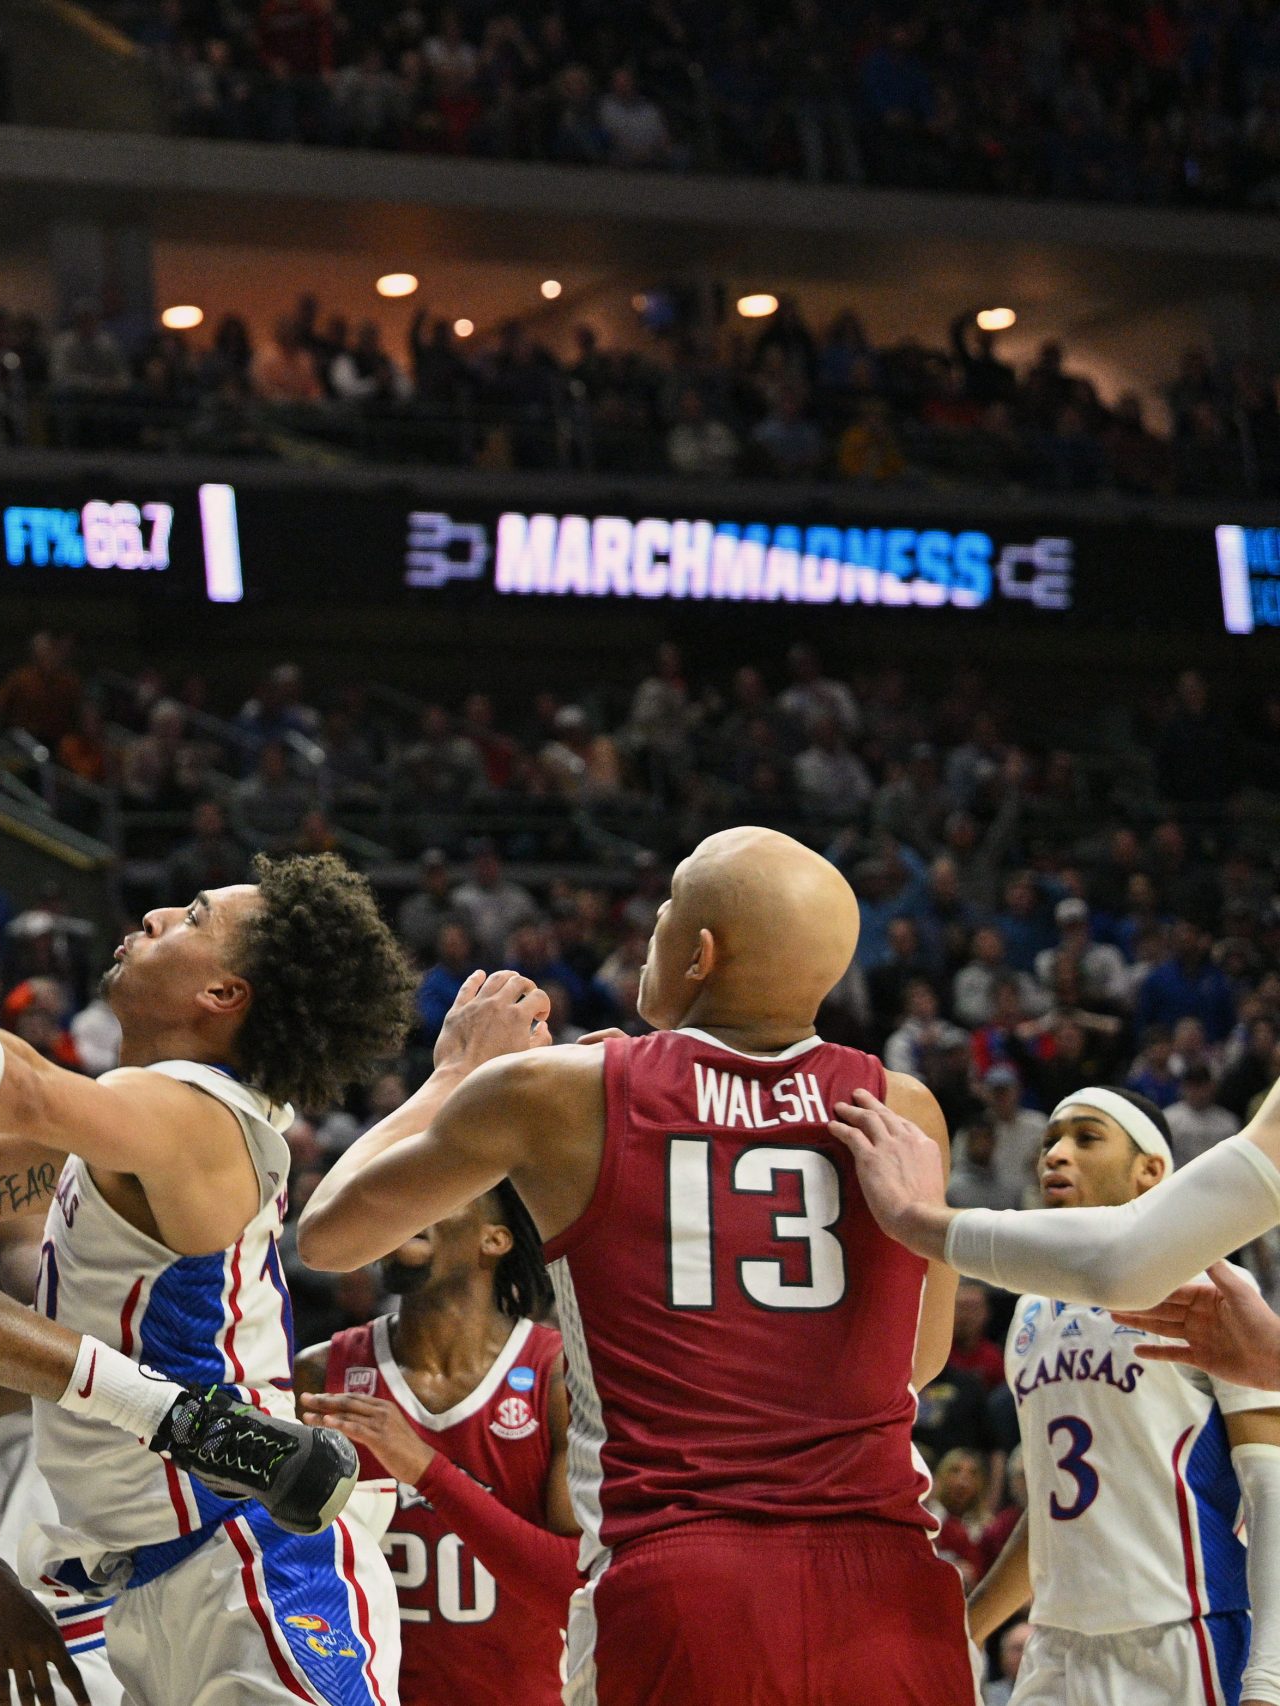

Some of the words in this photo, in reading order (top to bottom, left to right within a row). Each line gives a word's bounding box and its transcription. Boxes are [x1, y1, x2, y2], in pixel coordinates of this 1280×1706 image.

[82, 499, 174, 571] 66.7
[693, 1062, 829, 1128] WALSH
[665, 1135, 847, 1311] 13
[497, 1397, 530, 1427] SEC
[1014, 1348, 1145, 1407] KANSAS
[1047, 1414, 1101, 1521] 3
[379, 1531, 497, 1624] 20
